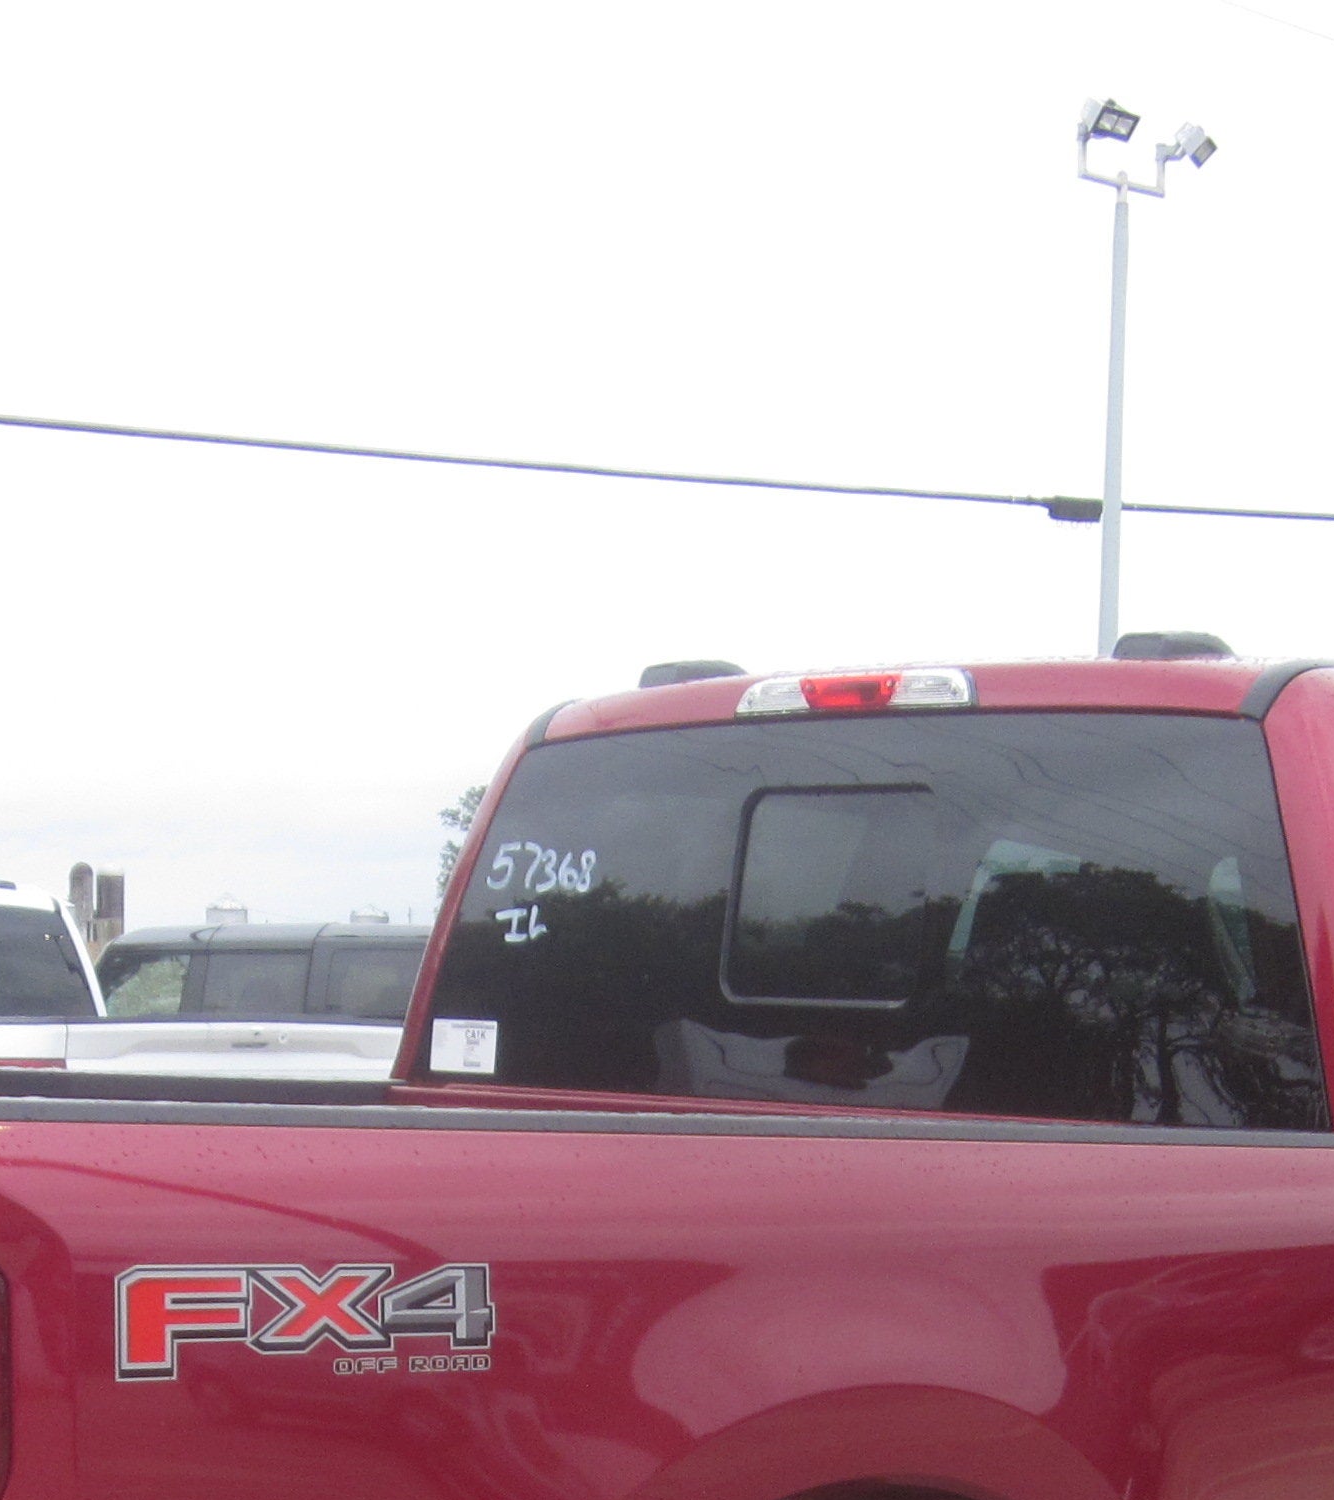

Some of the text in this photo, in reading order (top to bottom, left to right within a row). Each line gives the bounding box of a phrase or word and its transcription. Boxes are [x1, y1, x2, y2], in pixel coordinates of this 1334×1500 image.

[486, 841, 597, 893] 57368
[115, 1263, 495, 1382] FX4
[333, 1354, 492, 1375] OFF ROAD
